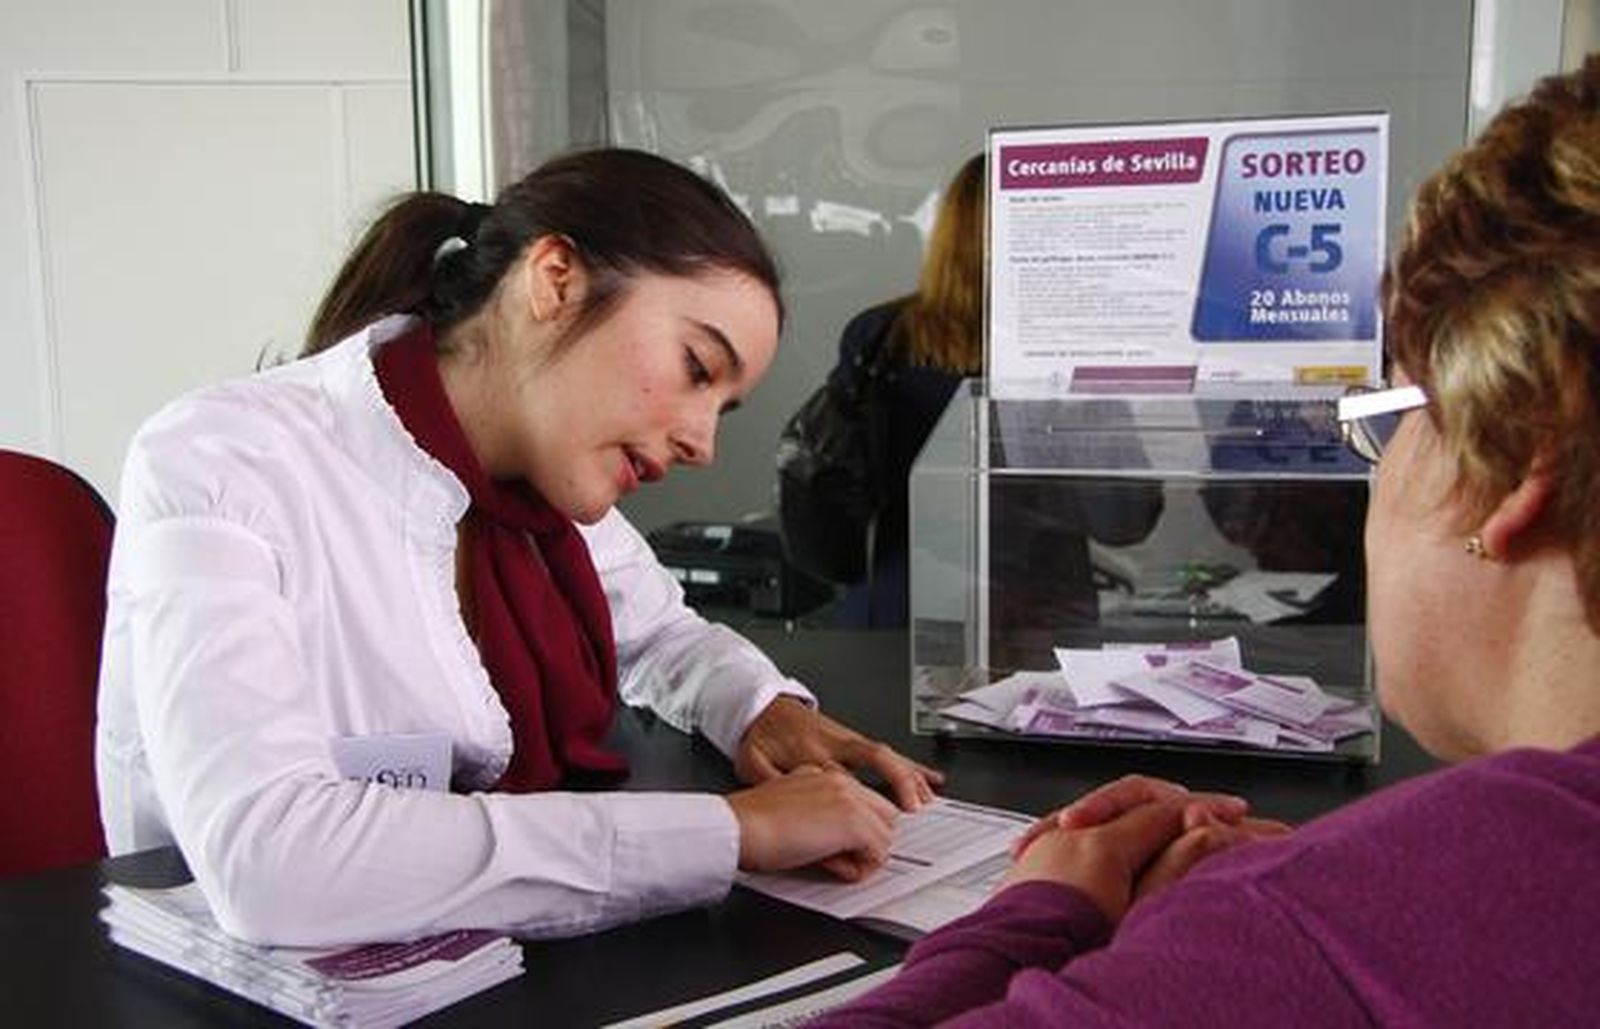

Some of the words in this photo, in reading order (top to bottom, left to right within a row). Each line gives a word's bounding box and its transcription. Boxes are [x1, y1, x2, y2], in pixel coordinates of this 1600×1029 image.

[1008, 157, 1096, 177] Cercanías
[1102, 154, 1125, 173] de
[1129, 152, 1198, 172] Sevilla
[1241, 149, 1366, 178] SORTEO
[1254, 188, 1346, 213] NUEVA
[1256, 223, 1343, 274] C-5
[1250, 290, 1276, 306] 20
[1281, 289, 1350, 306] Abonos
[1250, 306, 1350, 324] Mensuales
